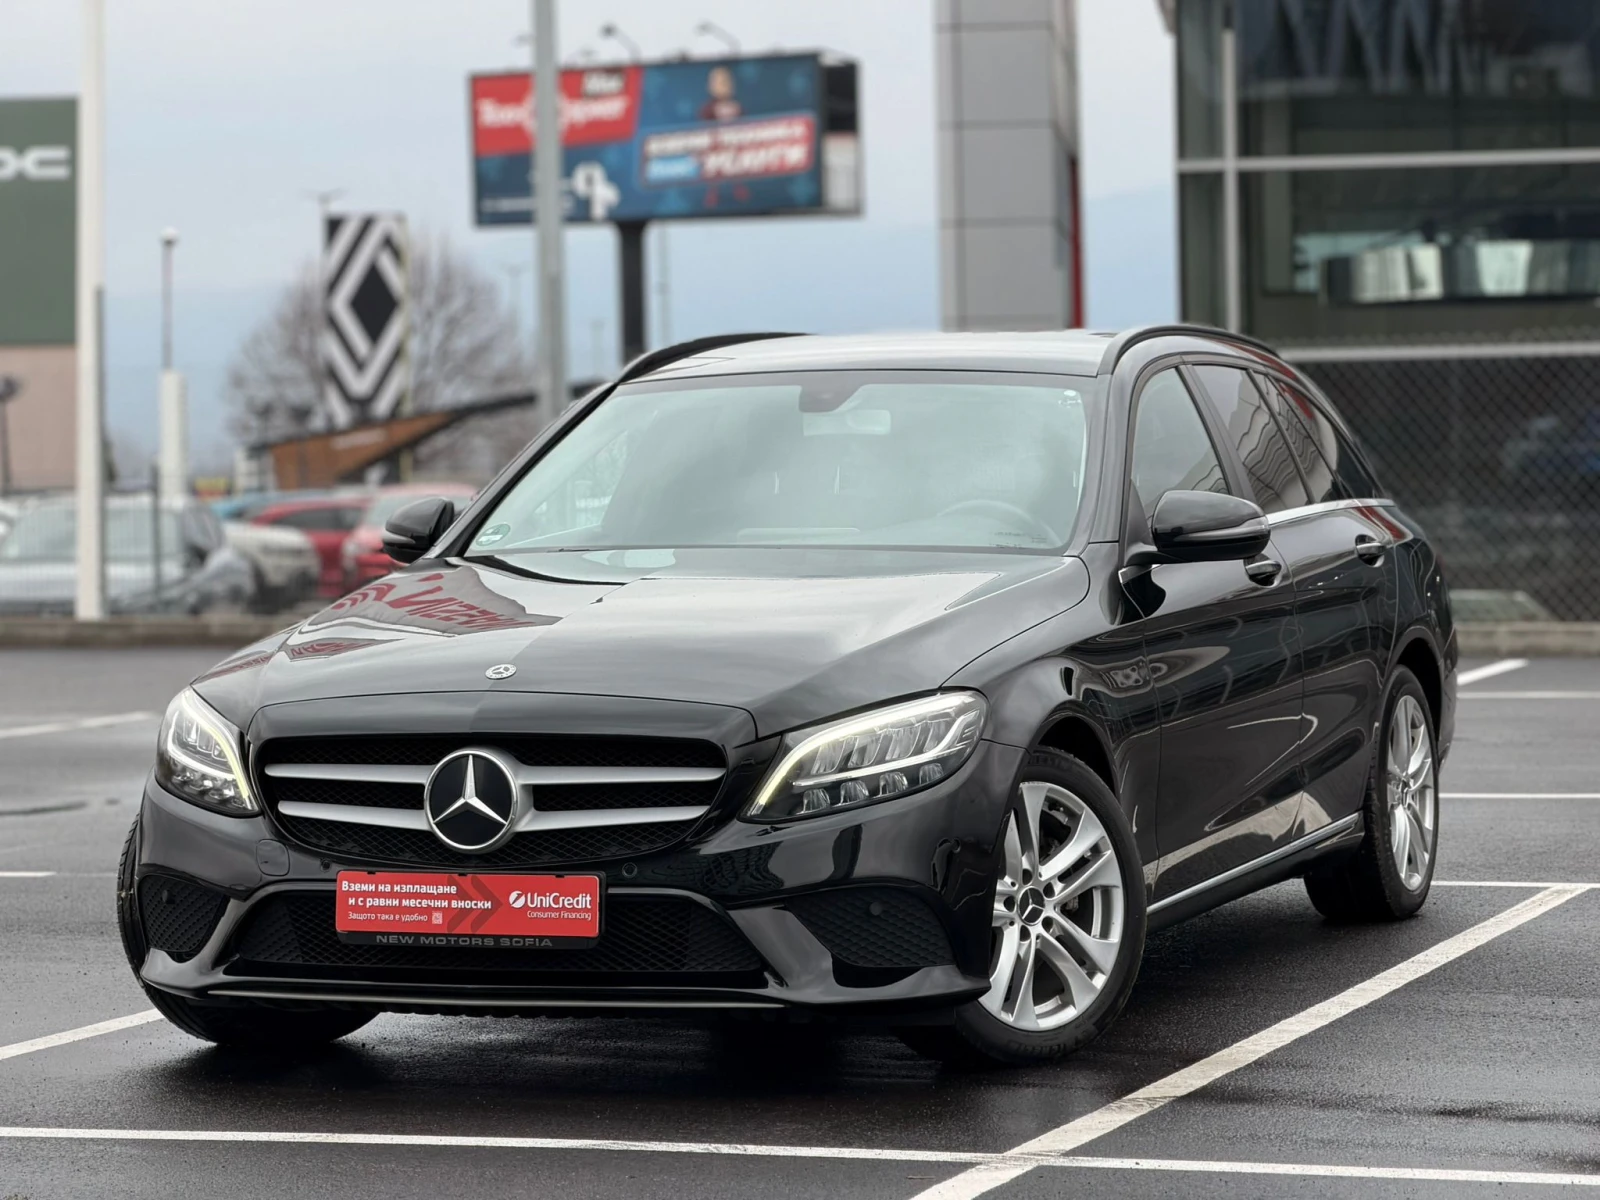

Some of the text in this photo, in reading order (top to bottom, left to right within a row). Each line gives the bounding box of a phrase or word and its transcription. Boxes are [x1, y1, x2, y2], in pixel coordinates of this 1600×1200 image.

[341, 880, 457, 895] Вземи на изплащане
[348, 897, 492, 910] и с равни месечни вноски
[526, 892, 592, 909] UniCredit
[348, 911, 375, 921] Защото
[377, 912, 394, 921] така
[401, 913, 427, 922] удобно
[527, 910, 592, 921] Consumer Financing
[376, 934, 553, 947] NEW MOTORS SOFIA
